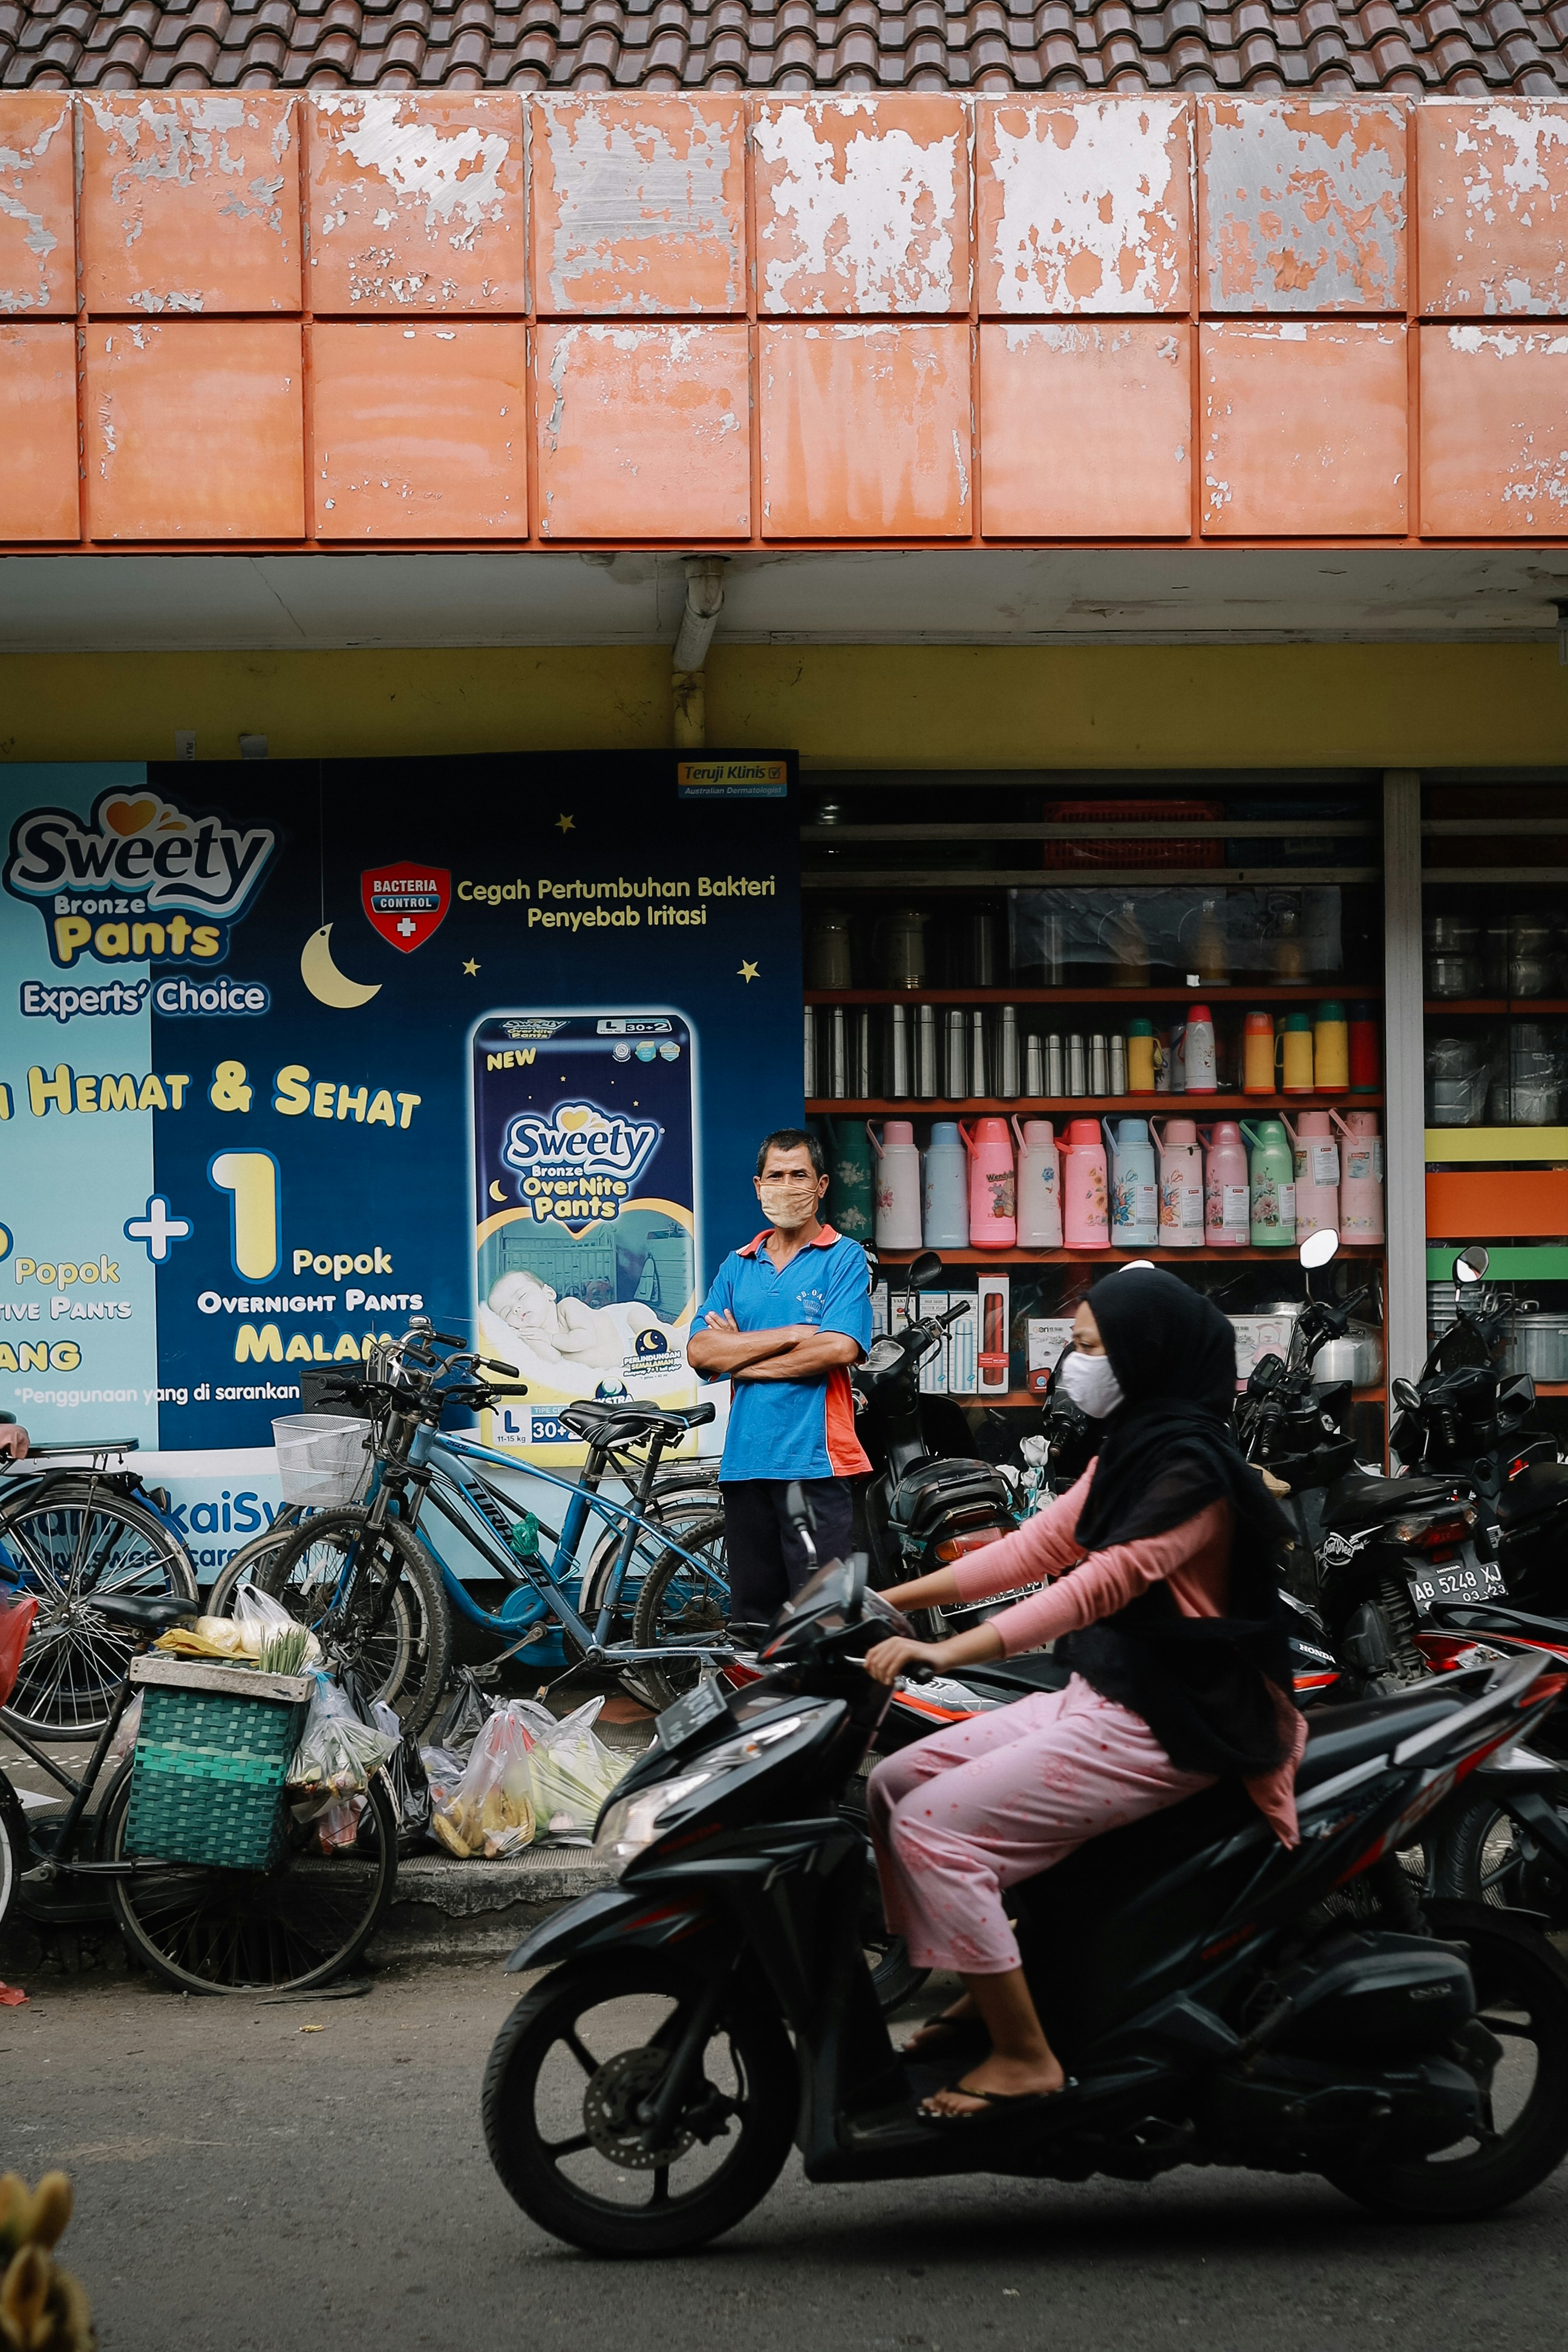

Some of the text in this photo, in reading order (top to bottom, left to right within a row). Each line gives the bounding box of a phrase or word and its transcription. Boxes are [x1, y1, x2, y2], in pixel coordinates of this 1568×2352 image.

[685, 765, 766, 783] Teruji Klinis
[727, 786, 782, 795] Dermatologist
[18, 823, 267, 899] Sweety
[373, 880, 437, 892] BACTERIA
[458, 875, 776, 906] Cegah Pertumbuhan Bakteri
[54, 896, 145, 914] Bronze
[380, 898, 432, 908] CONTROL
[528, 904, 707, 932] Penyebab Iritasi
[54, 915, 220, 962] Pants
[157, 980, 265, 1011] Choice
[606, 1021, 617, 1029] L
[487, 1047, 537, 1071] NEW
[27, 1063, 190, 1117] HEMAT
[211, 1060, 253, 1112] &
[274, 1064, 422, 1129] SEHAT
[512, 1124, 650, 1169] Sweety
[532, 1165, 584, 1177] Bronze
[523, 1175, 627, 1196] OverNite
[534, 1195, 616, 1221] Pants
[15, 1255, 120, 1291] Popok
[293, 1247, 393, 1281] Popok
[50, 1296, 132, 1320] PANTS
[197, 1288, 424, 1315] OVERNIGHT PANTS
[624, 1351, 681, 1365] PERLINDUNGAN
[631, 1359, 673, 1370] SEMALAMAN
[144, 1385, 189, 1406] yang
[193, 1383, 210, 1401] di
[215, 1383, 300, 1400] sarankan
[505, 1410, 520, 1434] L
[1414, 1581, 1436, 1601] AB
[1438, 1570, 1477, 1595] 5248
[1298, 1643, 1336, 1664] HONDA
